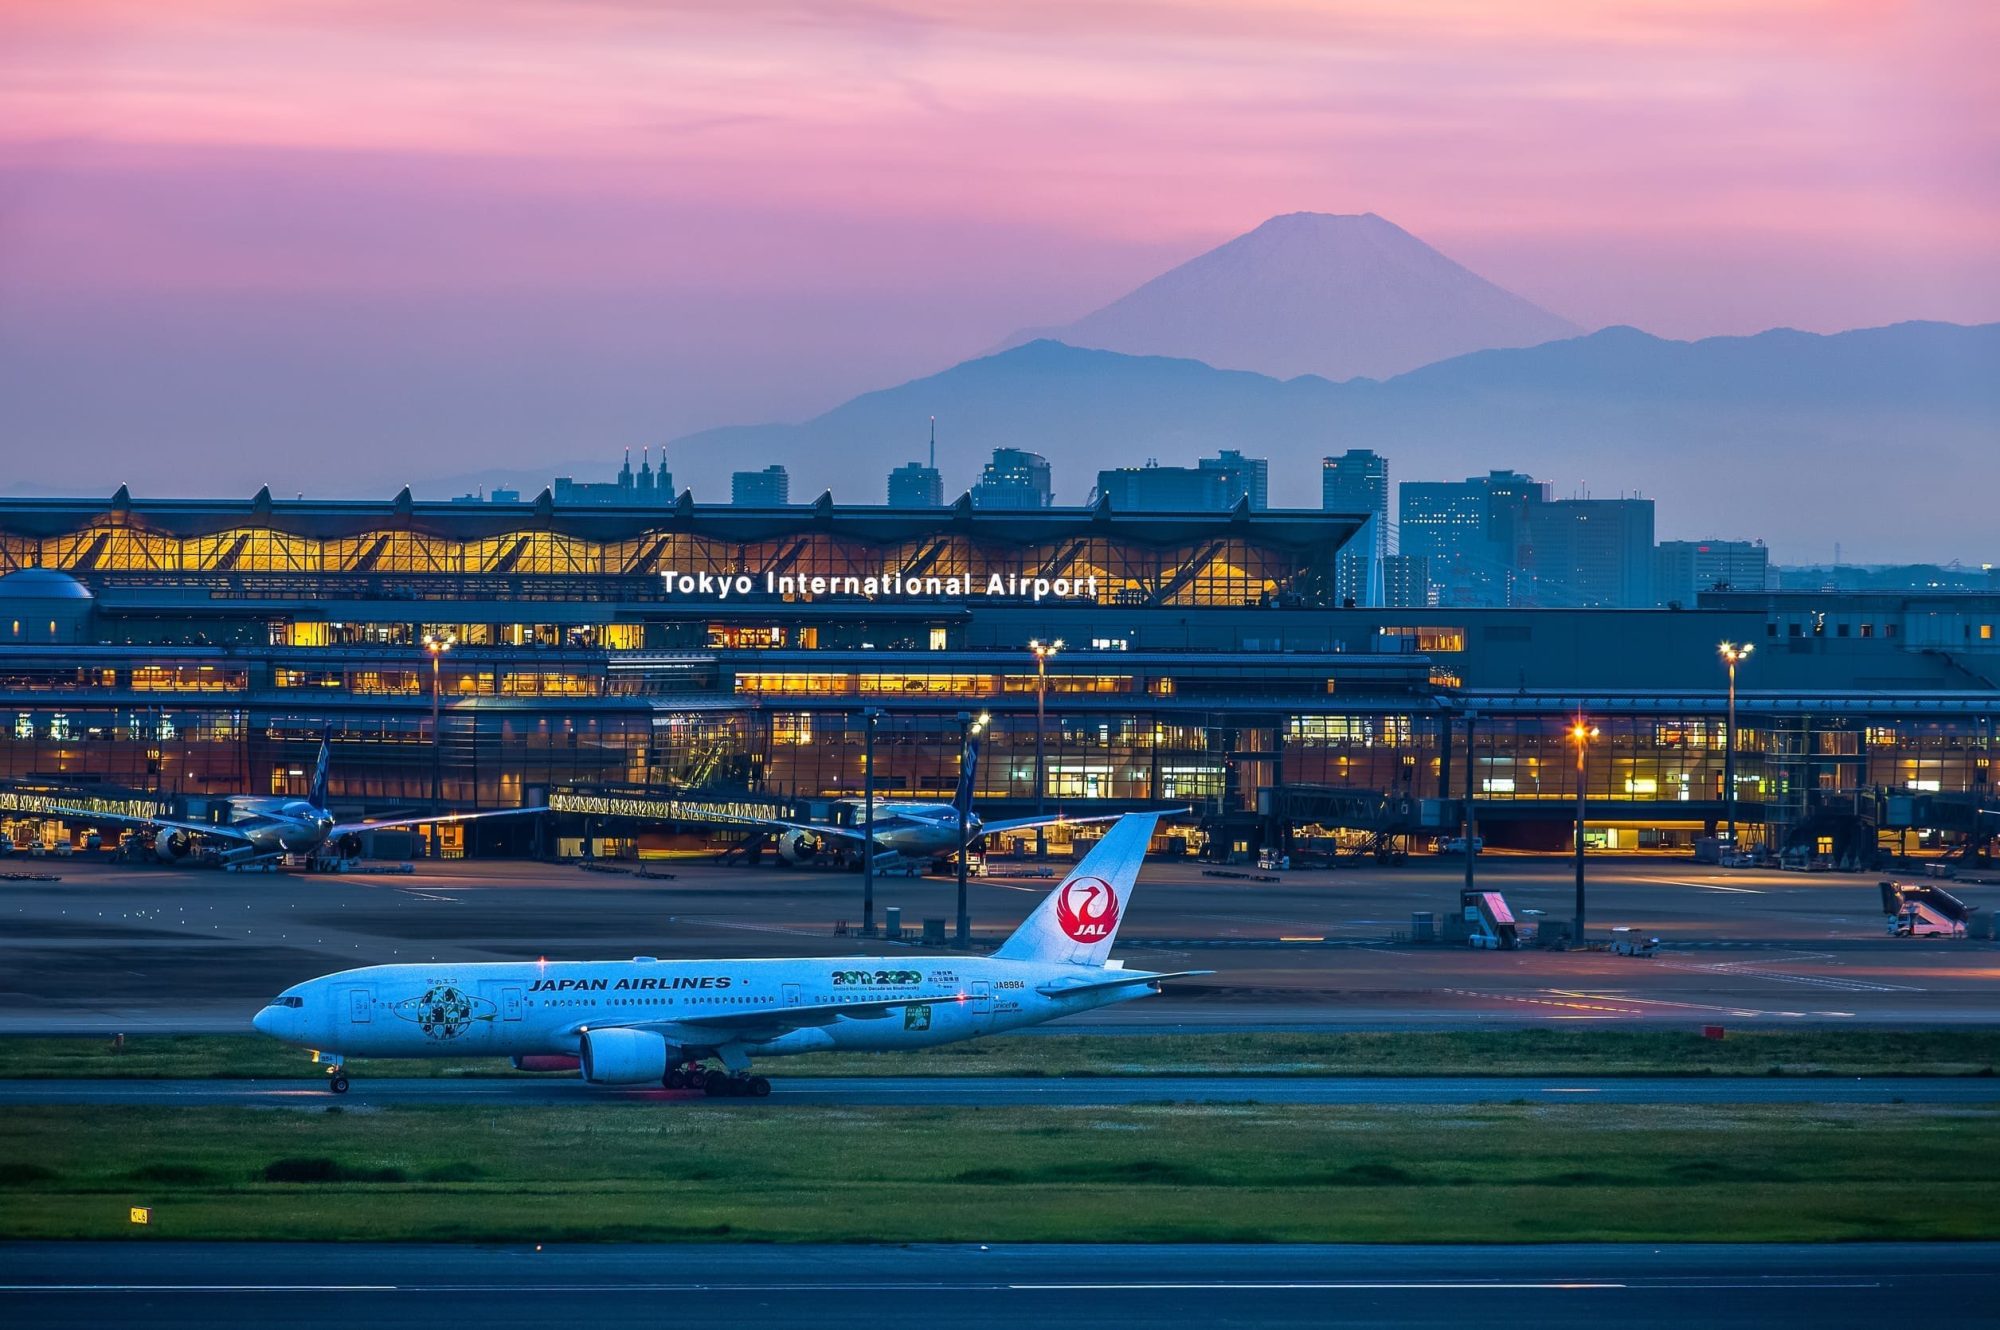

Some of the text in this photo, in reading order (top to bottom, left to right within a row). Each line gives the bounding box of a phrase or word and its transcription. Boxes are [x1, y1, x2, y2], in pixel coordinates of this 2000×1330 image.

[660, 571, 1097, 601] Tokyo International Airport
[147, 750, 160, 758] 110
[1402, 756, 1416, 765] 112
[1073, 924, 1107, 935] JAL
[528, 977, 732, 992] JAPAN AIRLINES
[993, 981, 1025, 989] JA8984
